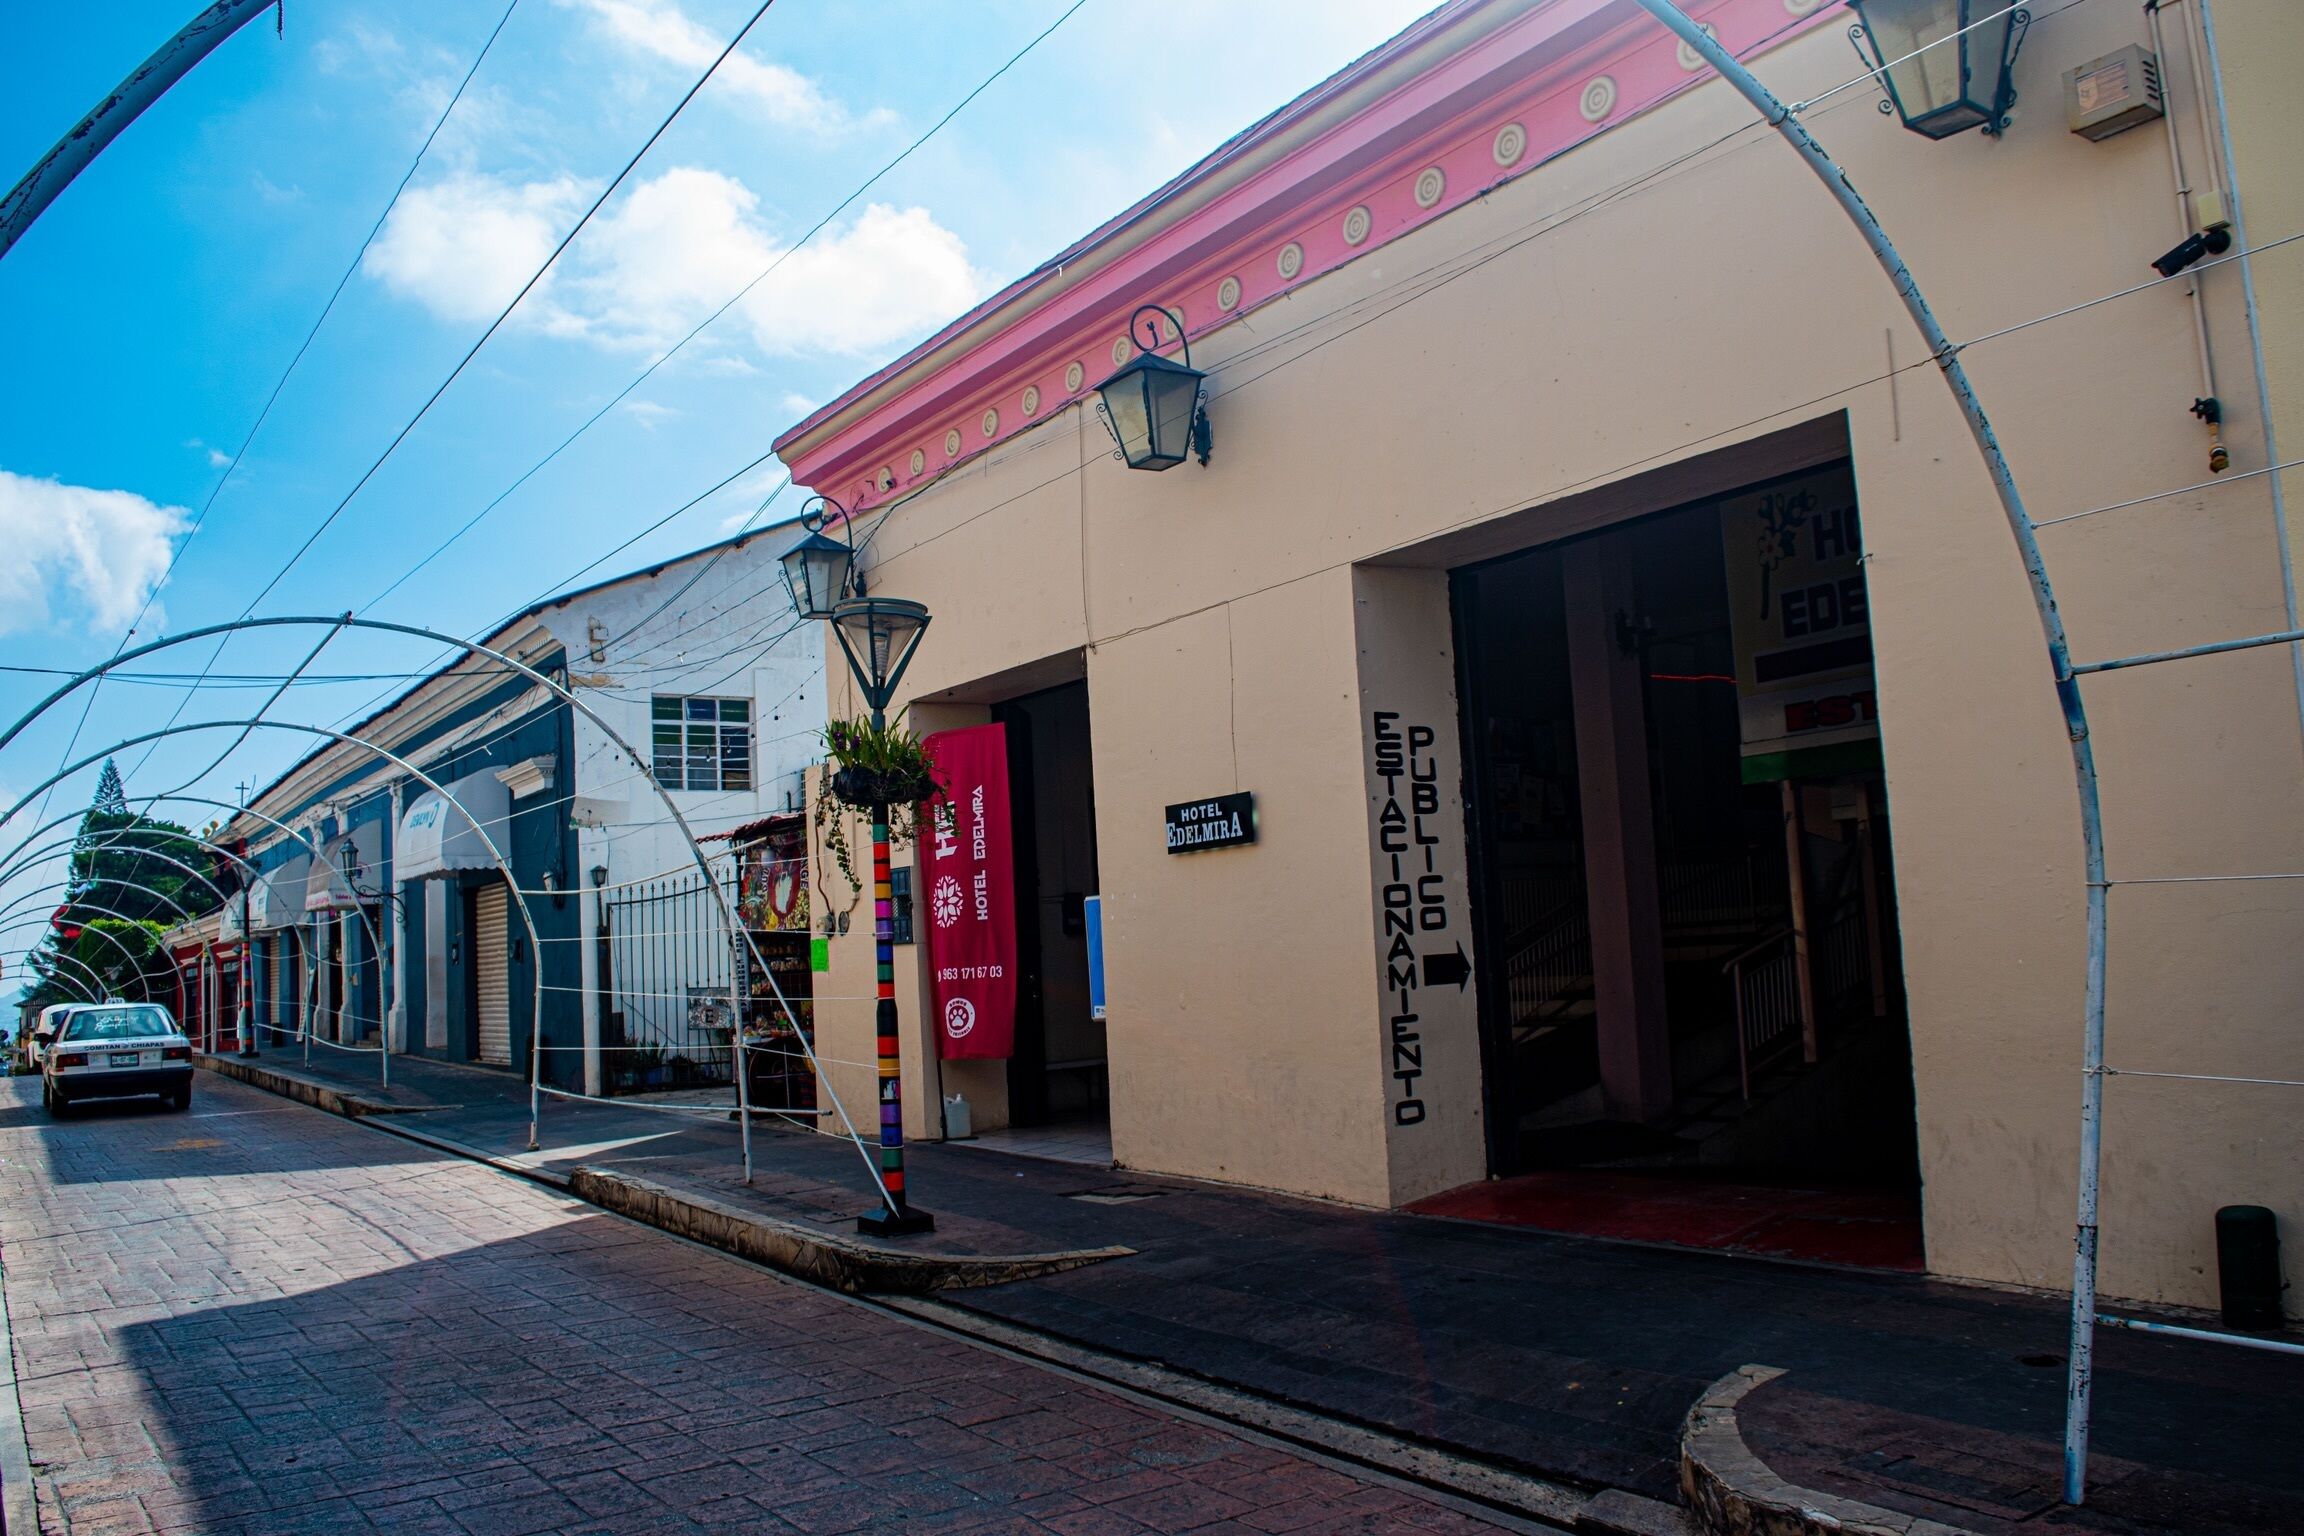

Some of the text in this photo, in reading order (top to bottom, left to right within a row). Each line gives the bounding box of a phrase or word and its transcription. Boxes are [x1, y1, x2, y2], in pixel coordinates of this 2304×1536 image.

[1166, 811, 1243, 848] EDELMIRA
[1181, 802, 1223, 822] HOTEL
[1408, 726, 1447, 931] PUBLICO
[972, 784, 989, 921] HOTEL EDELMIRA
[1374, 711, 1426, 1126] ESTACIONAMIENTO
[942, 965, 1003, 980] 963 171 67 03
[84, 1041, 165, 1051] COMITAN CHIAPAS
